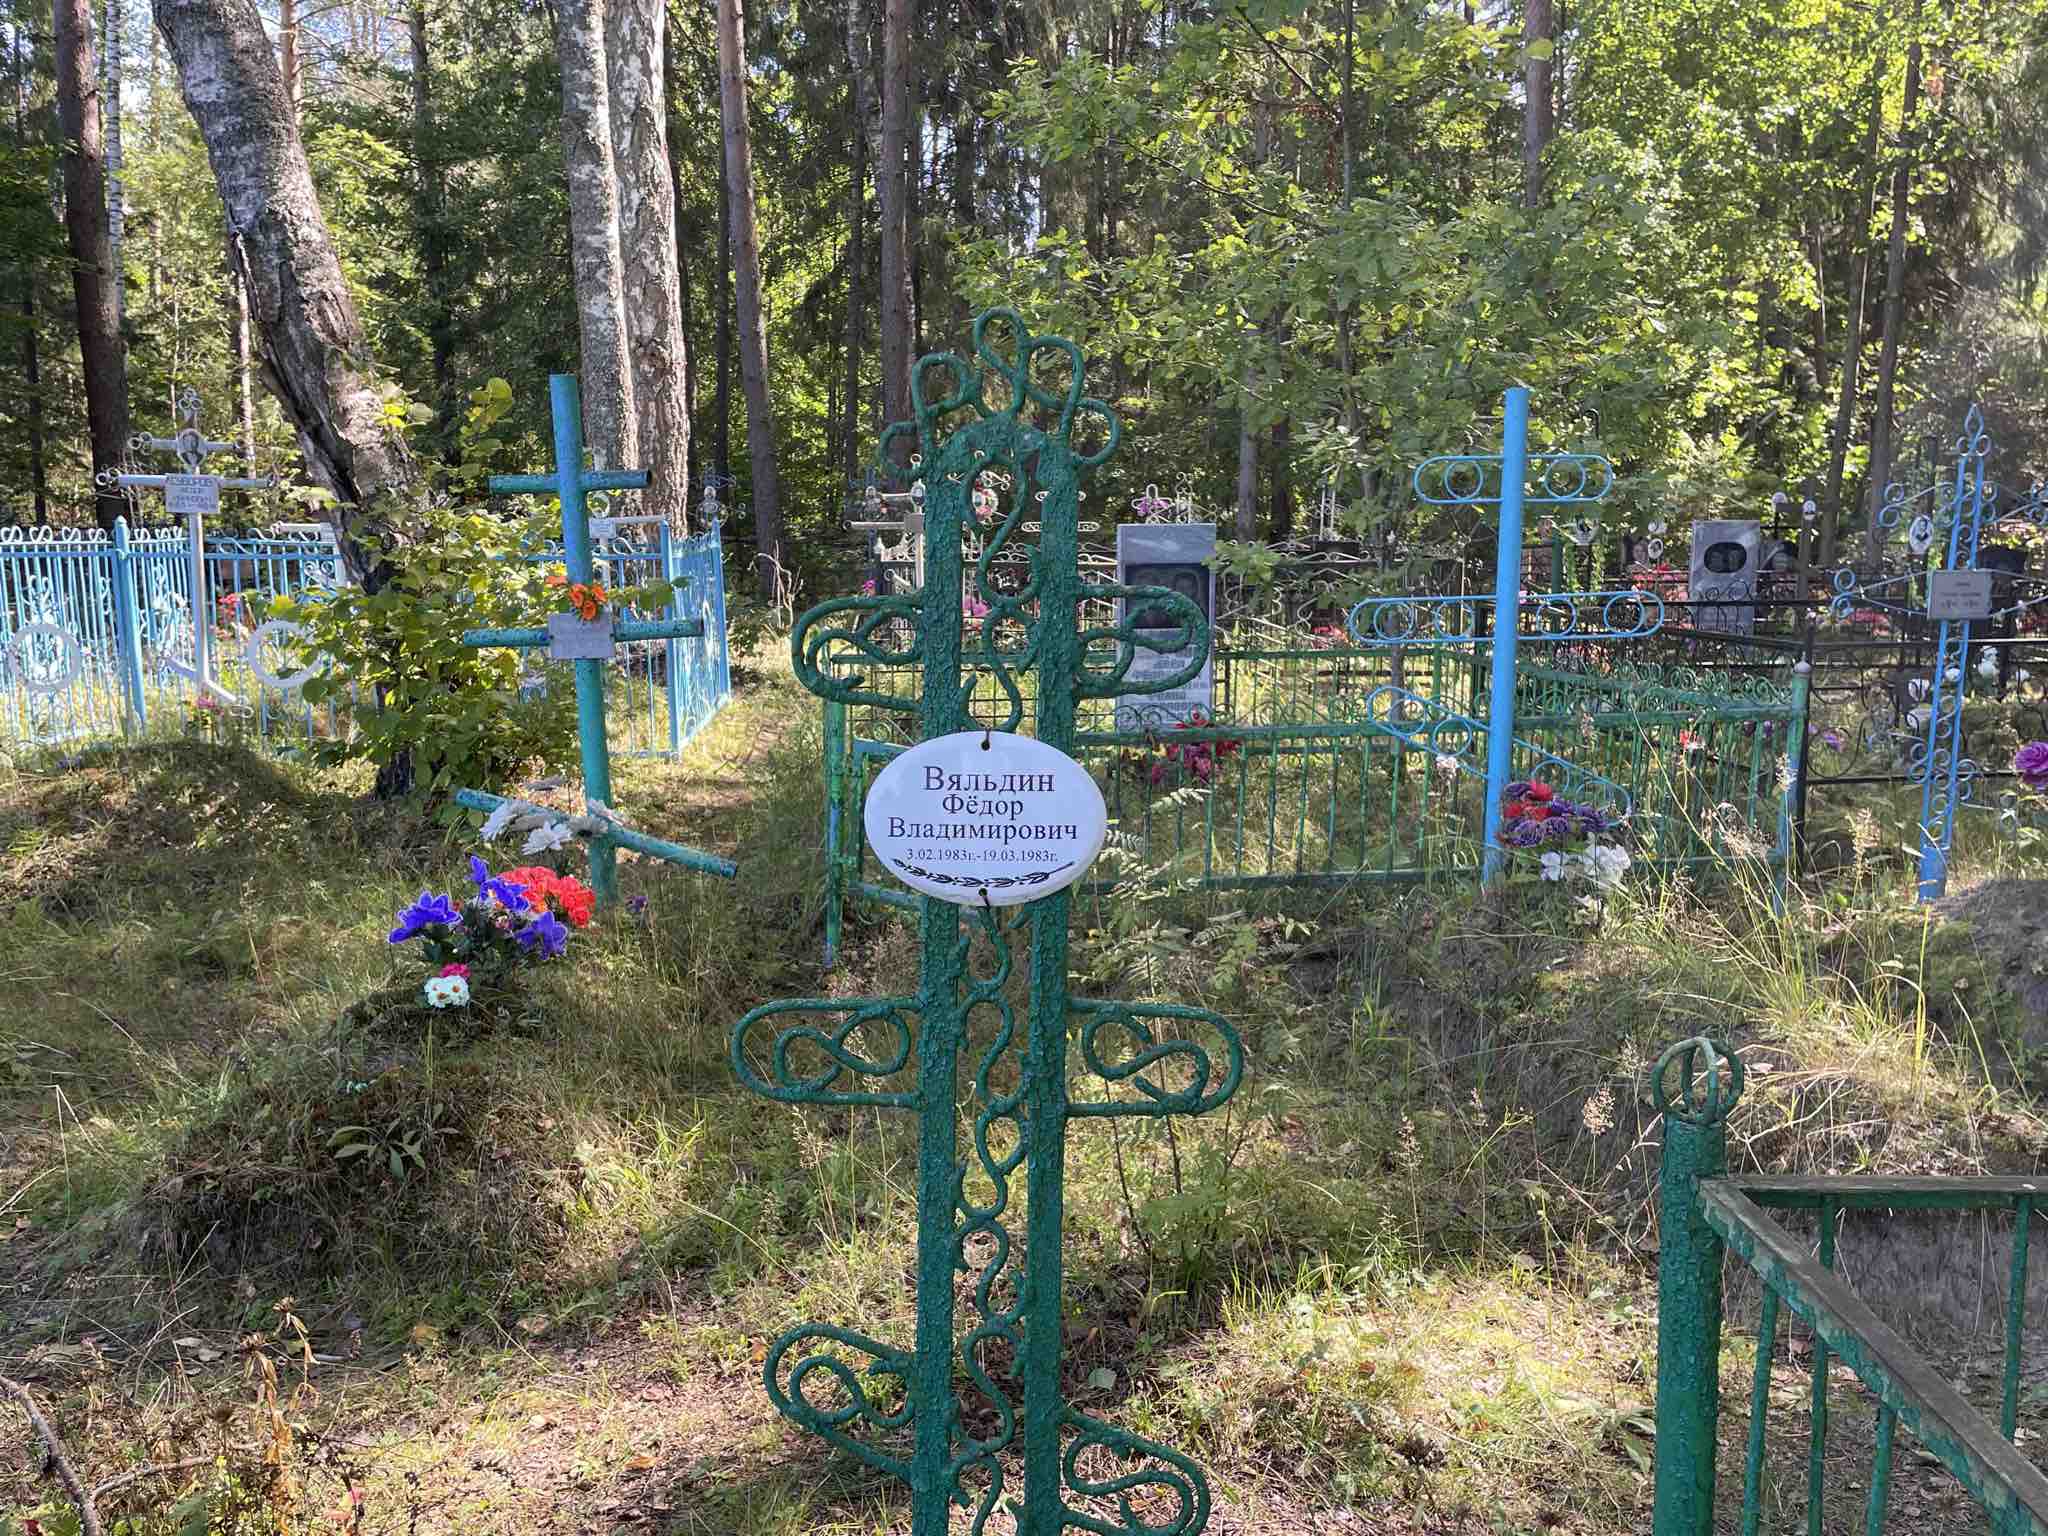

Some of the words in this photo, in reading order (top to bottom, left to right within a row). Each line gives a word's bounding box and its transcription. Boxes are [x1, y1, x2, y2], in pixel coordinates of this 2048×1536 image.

[924, 765, 1056, 791] Вяльдин
[943, 794, 1023, 821] Фёдор
[888, 816, 1077, 845] Владимирович
